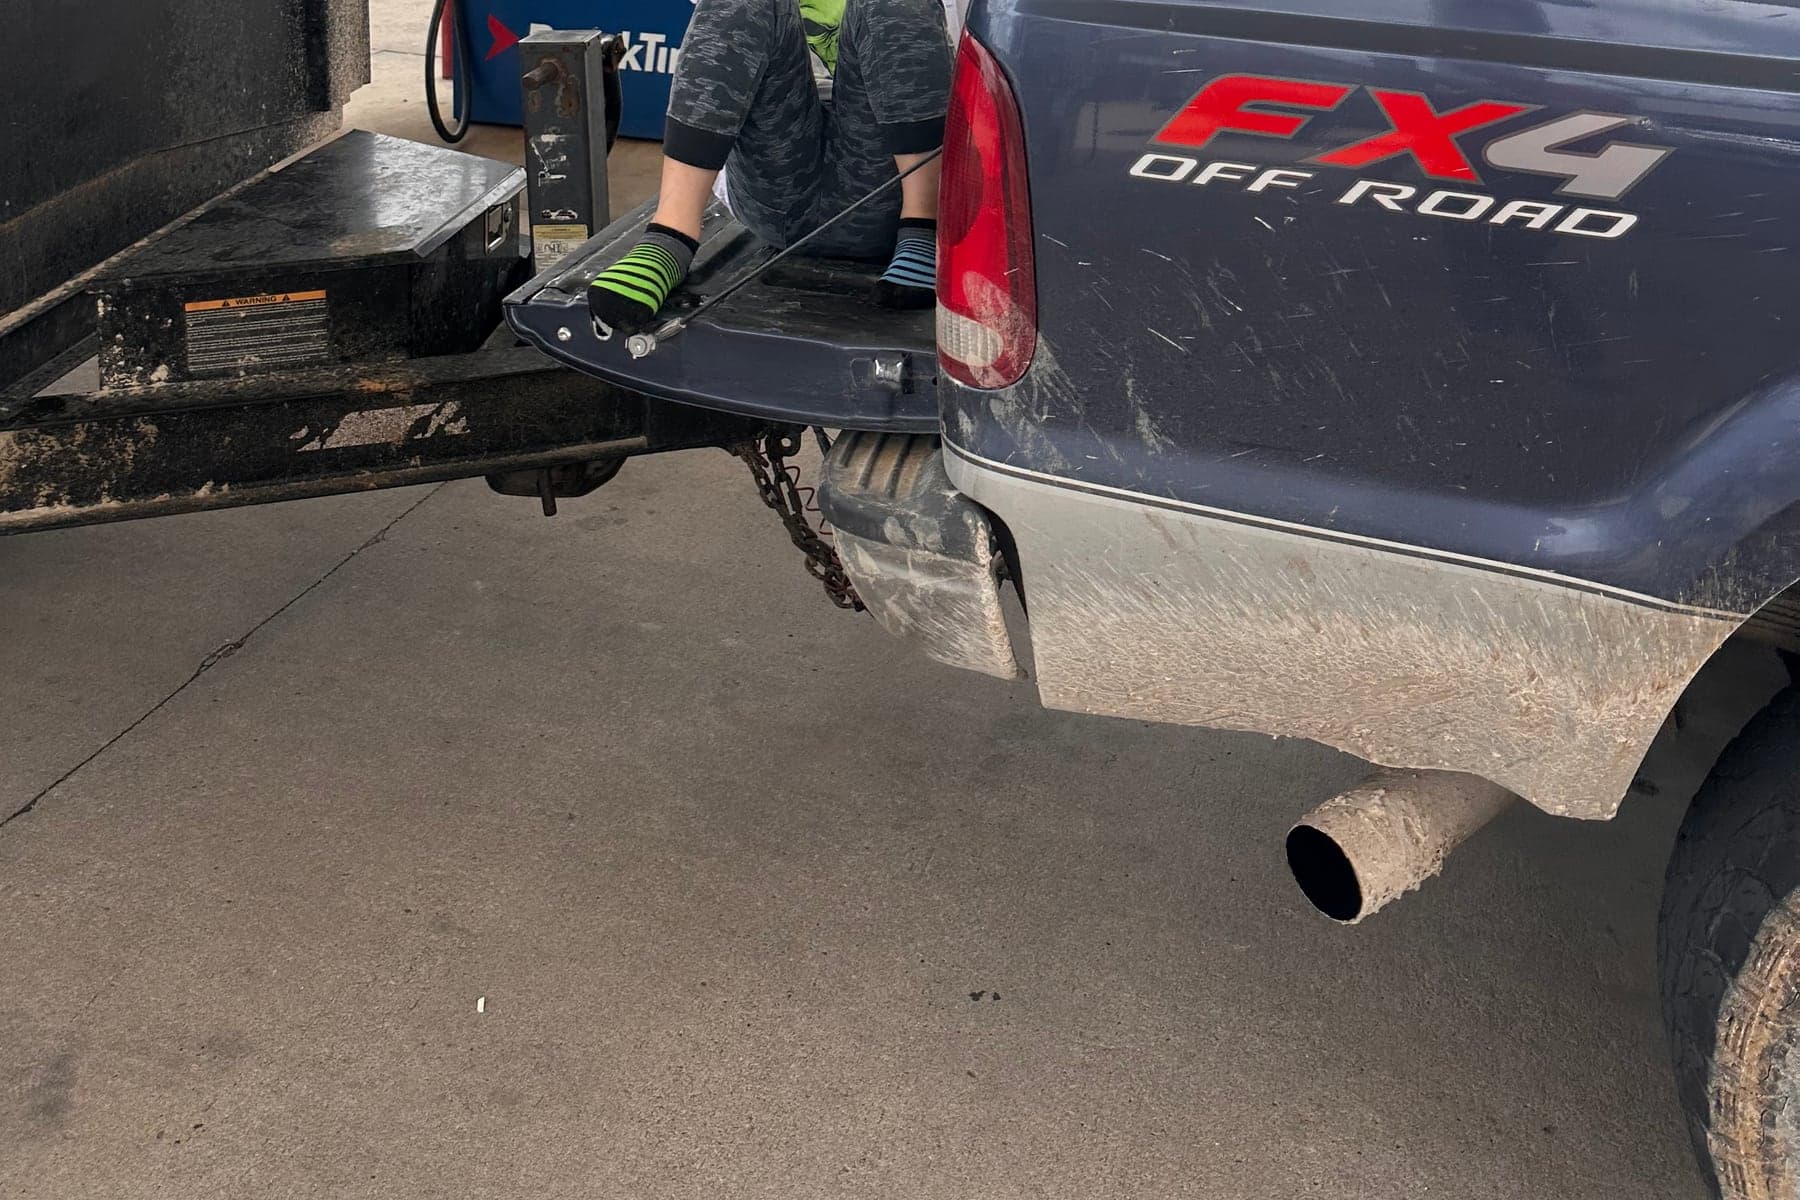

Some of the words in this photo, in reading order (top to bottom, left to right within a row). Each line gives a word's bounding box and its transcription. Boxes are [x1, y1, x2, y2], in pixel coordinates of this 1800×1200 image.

[1150, 73, 1676, 199] FX4
[1128, 153, 1313, 193] OFF
[1337, 179, 1639, 239] ROAD
[235, 295, 277, 306] WARNING
